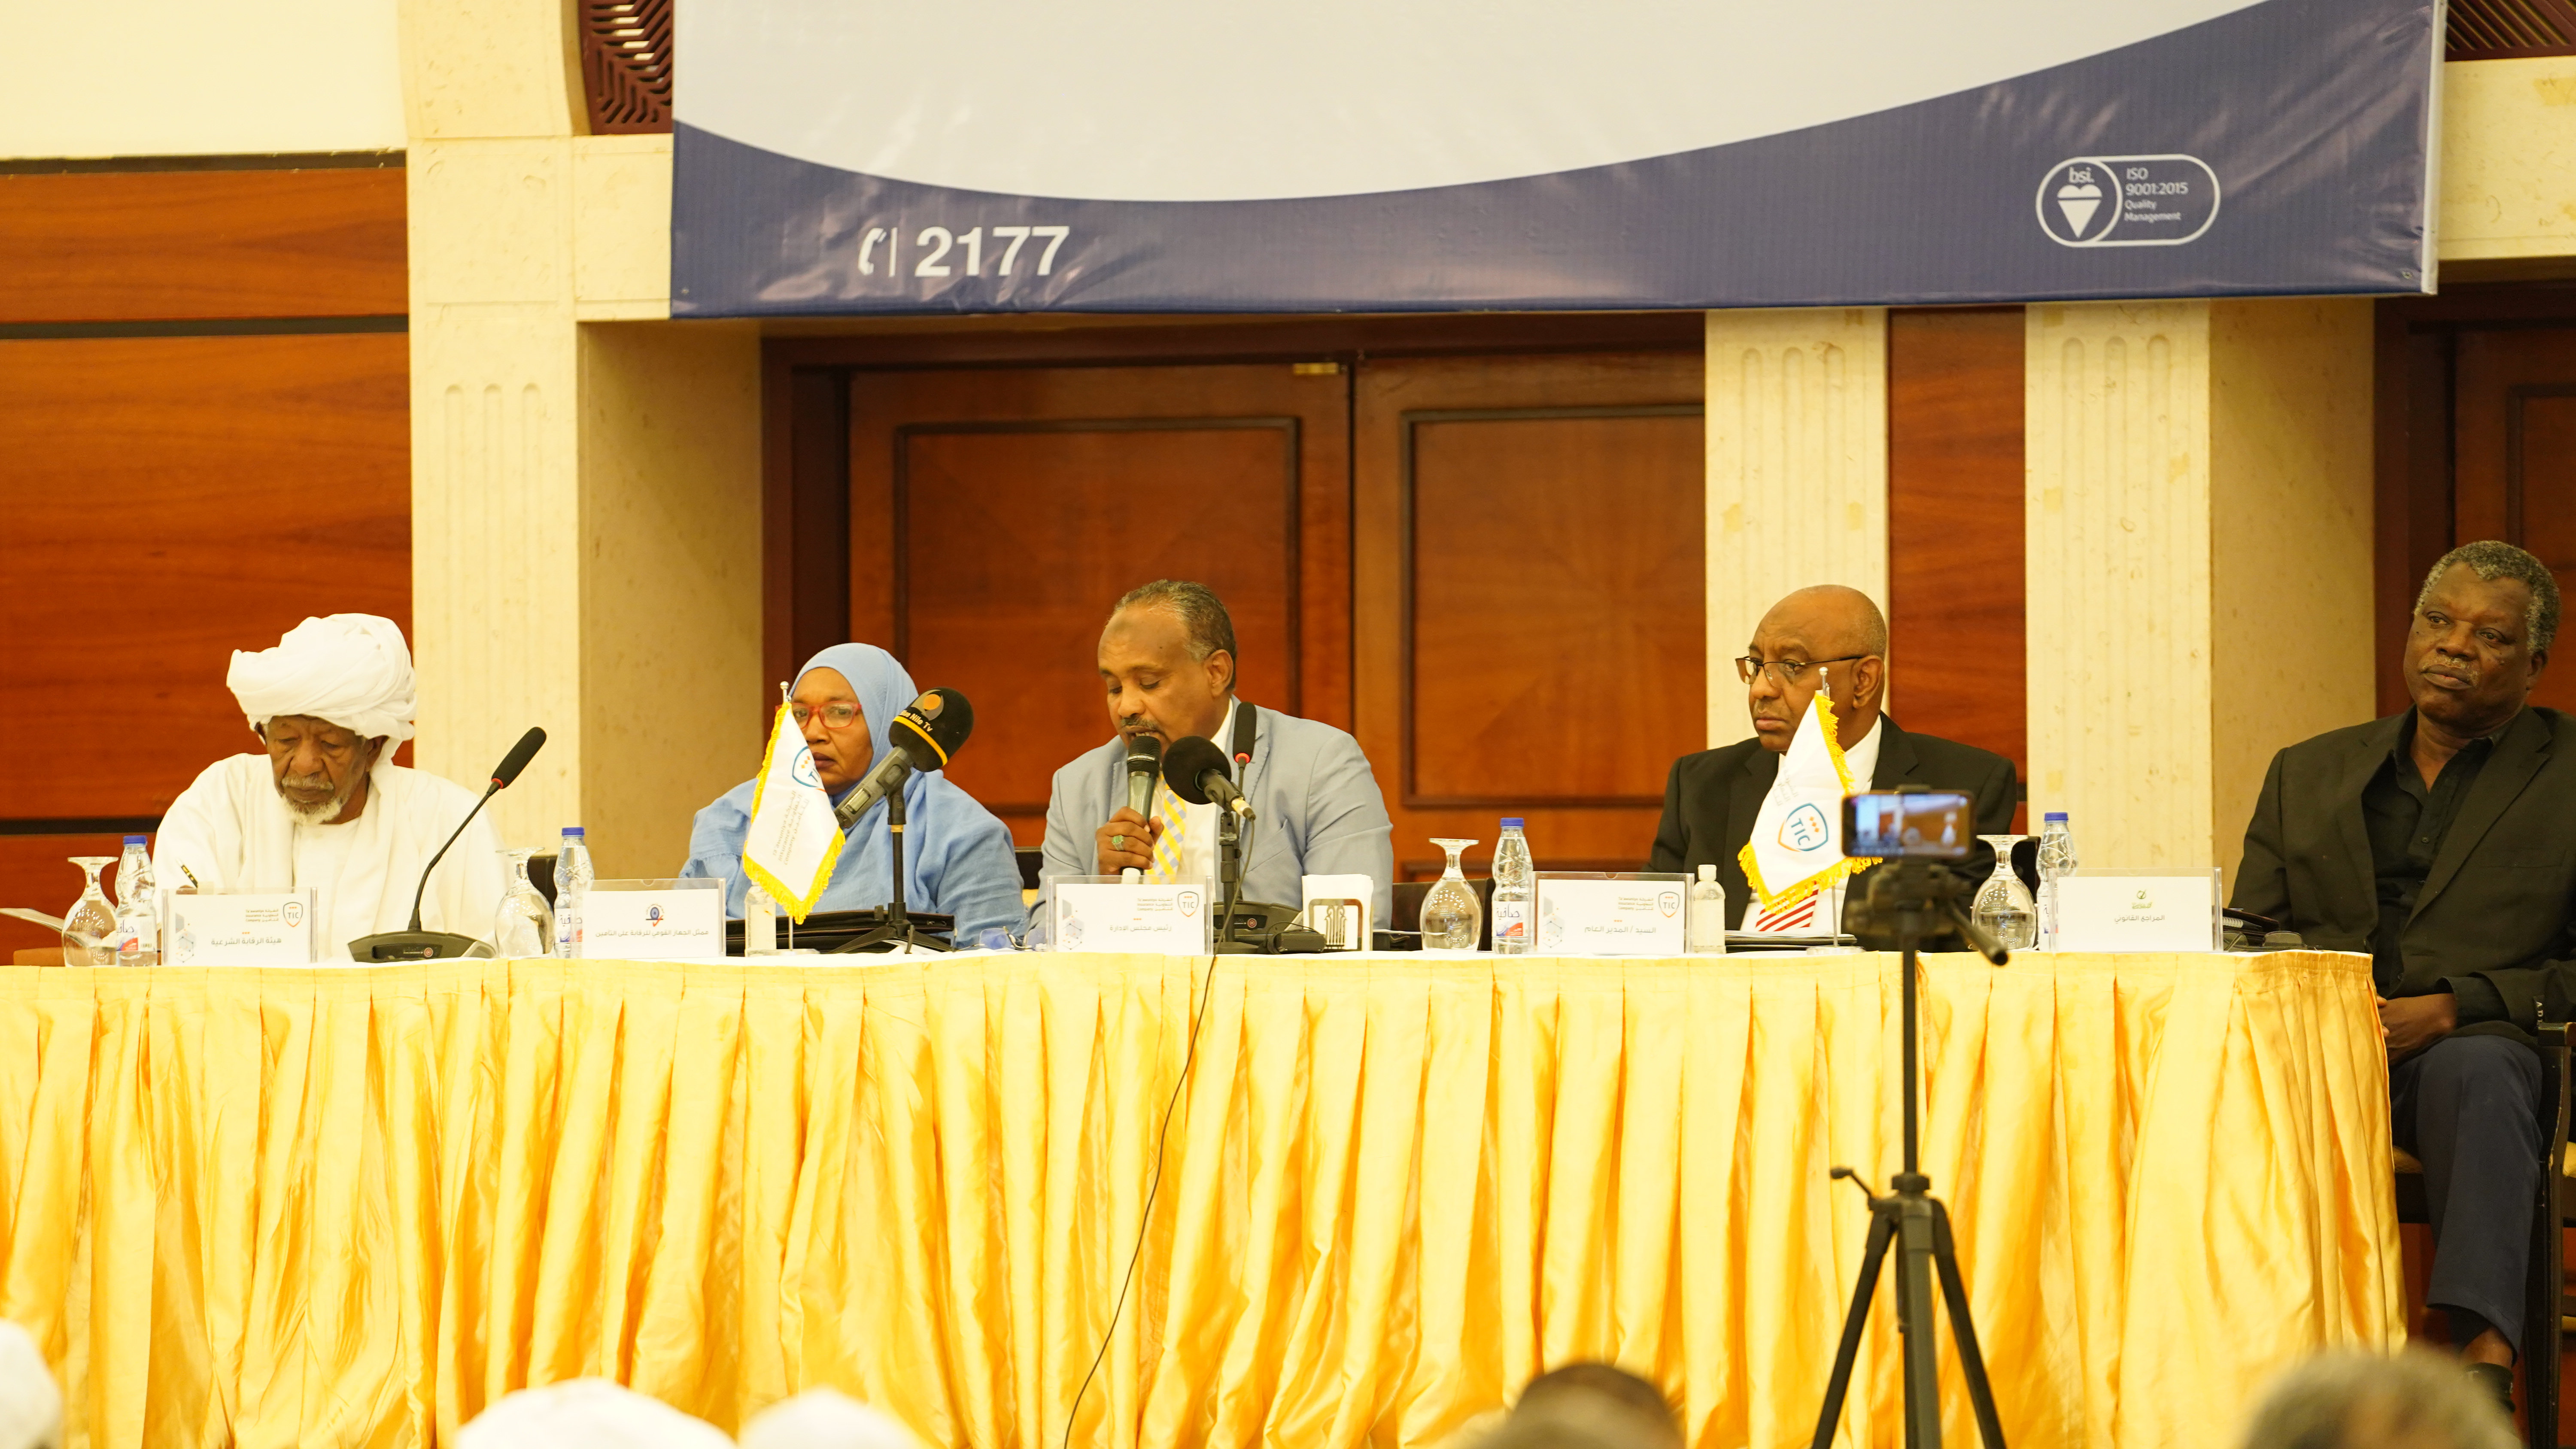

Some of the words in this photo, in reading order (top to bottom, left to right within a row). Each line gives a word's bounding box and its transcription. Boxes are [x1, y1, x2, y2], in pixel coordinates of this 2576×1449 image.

[2126, 167, 2148, 180] ISO
[2125, 182, 2188, 196] 9001:2015
[2124, 200, 2156, 210] Quality
[2124, 212, 2181, 223] Management
[914, 226, 1070, 277] 2177
[909, 713, 923, 725] Nile
[923, 721, 933, 732] Tv
[1791, 818, 1810, 846] TIC
[1496, 903, 1520, 920] صافية
[2114, 915, 2139, 924] القانوني
[630, 929, 650, 937] للرقابة
[652, 930, 671, 938] القومي
[1636, 927, 1656, 935] السيد
[211, 937, 240, 947] الشرعية
[241, 937, 264, 946] الرقابة
[265, 937, 282, 945] هيئة
